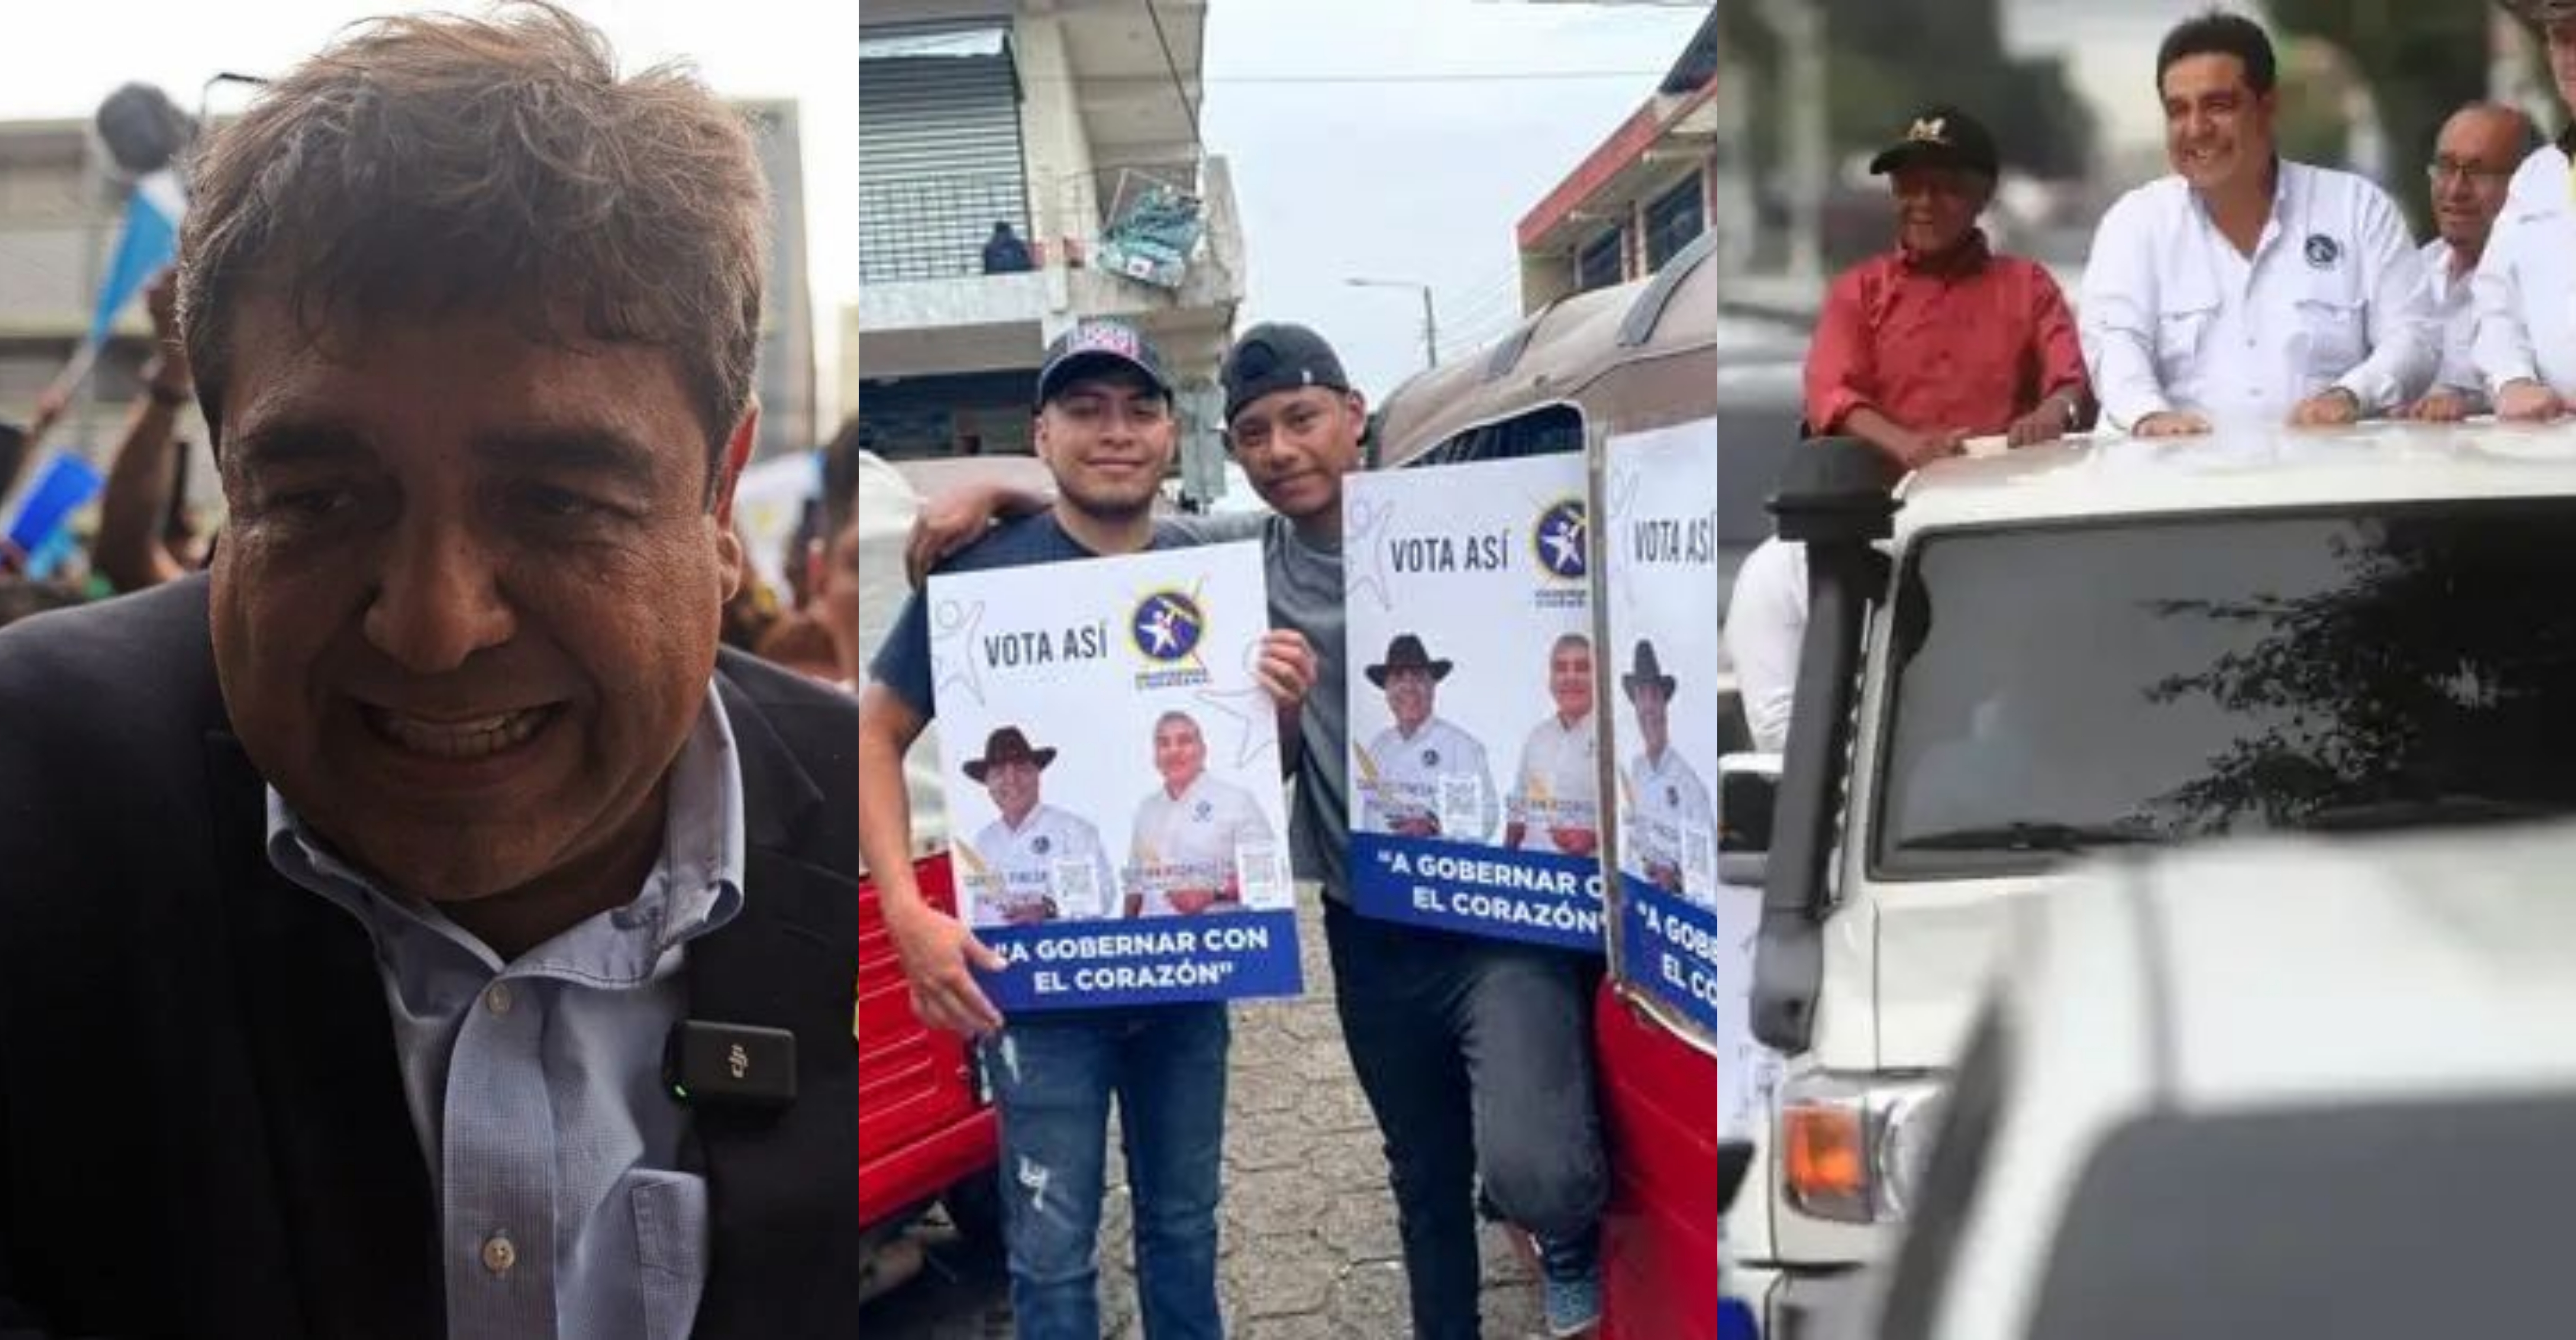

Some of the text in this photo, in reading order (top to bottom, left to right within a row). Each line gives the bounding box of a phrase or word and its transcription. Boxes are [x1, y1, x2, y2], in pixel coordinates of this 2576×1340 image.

[1389, 529, 1510, 573] VOTA ASÍ
[1634, 519, 1680, 564] VOTA
[984, 621, 1107, 669] VOTA ASÍ
[1416, 853, 1577, 895] GOBERNAR
[1412, 885, 1447, 913] EL
[1035, 931, 1196, 961] GOBERNAR
[1203, 926, 1269, 952] CON
[1033, 960, 1233, 994] EL CORAZÓN"
[1662, 952, 1687, 989] EL
